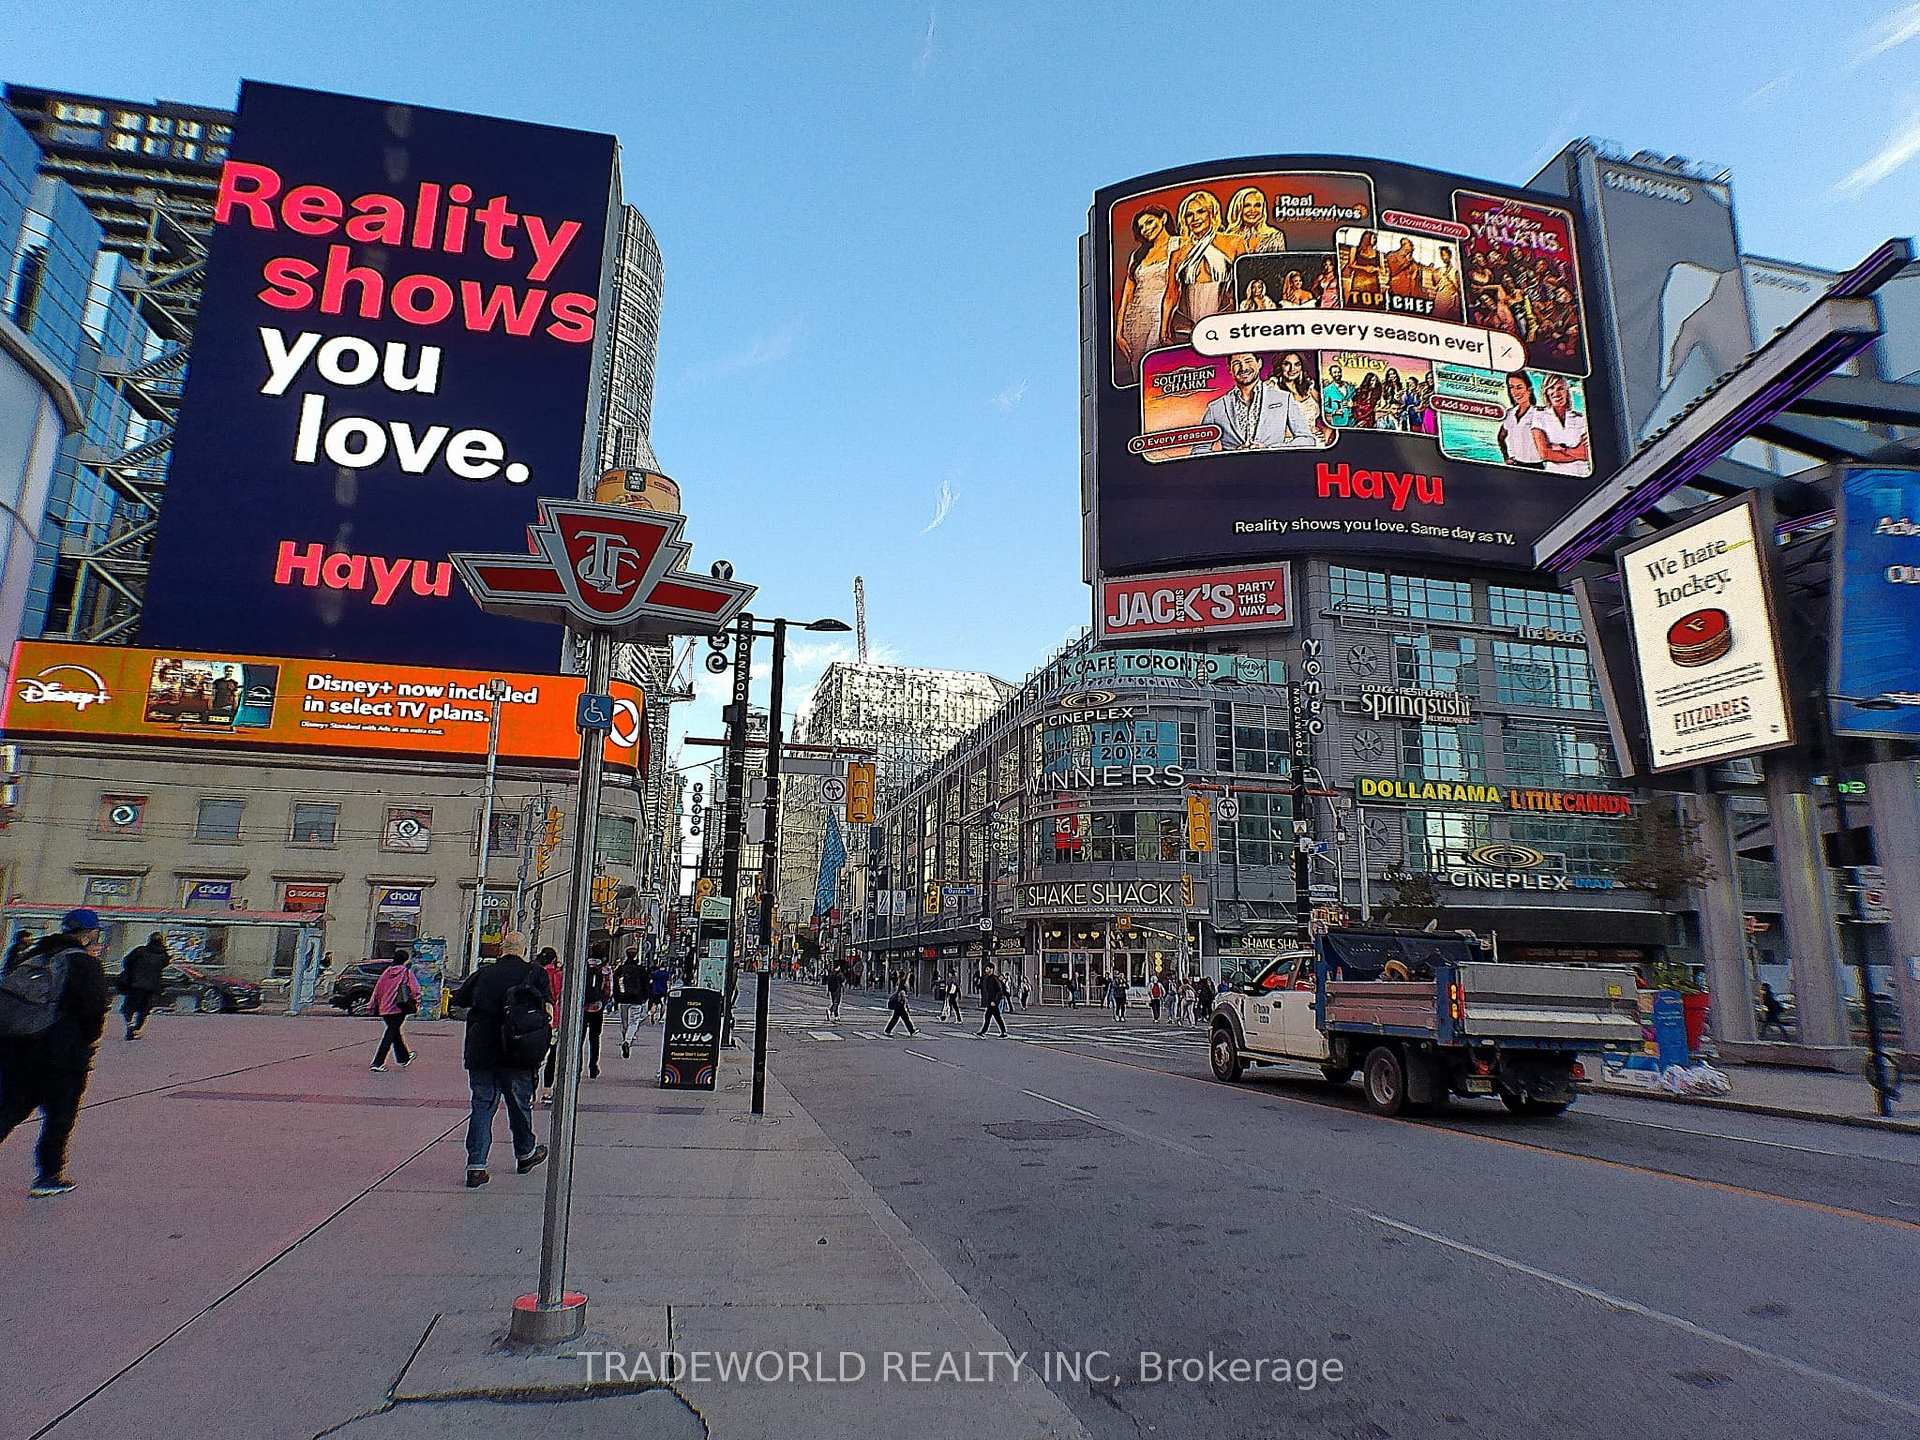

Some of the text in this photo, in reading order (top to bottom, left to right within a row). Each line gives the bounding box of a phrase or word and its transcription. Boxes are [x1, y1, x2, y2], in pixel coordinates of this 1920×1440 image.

[1275, 205, 1361, 220] Housewives
[1281, 195, 1312, 206] Real
[214, 160, 582, 281] Reality
[257, 244, 598, 345] shows
[1349, 290, 1434, 314] TOP CHEF
[1229, 323, 1485, 354] stream every season ever
[258, 327, 442, 396] you
[1154, 370, 1216, 388] SOUTHERN
[1163, 379, 1207, 395] CHARM
[294, 394, 531, 485] love.
[1147, 428, 1214, 448] Every season
[1316, 462, 1445, 511] Hayu
[1235, 517, 1517, 545] Reality shows you love. Same day as TV.
[273, 540, 453, 606] Hayu
[1645, 540, 1728, 581] We hate
[1238, 580, 1275, 593] PARTY
[1238, 593, 1267, 605] THIS
[1654, 568, 1732, 608] hockey.
[1108, 584, 1235, 628] JACK'S
[1176, 589, 1185, 622] ASTORS
[1239, 605, 1266, 617] WAY
[735, 620, 750, 701] DOWNTOWN
[1075, 656, 1118, 675] CAFE
[307, 674, 394, 698] Disney+
[398, 682, 444, 698] now
[1302, 639, 1323, 735] Yonge
[1361, 684, 1396, 694] LOUNGE
[303, 695, 491, 724] in select TV plans.
[1048, 707, 1135, 728] CINEPLEX
[1292, 688, 1304, 756] DOWNTOWN
[1674, 696, 1750, 730] FITZDARES
[1026, 765, 1185, 797] WINNERS
[1360, 778, 1501, 804] DOLLARAMA
[1510, 788, 1632, 816] LITTLE CANADA
[1029, 883, 1174, 906] SHAKE SHACK
[1450, 871, 1570, 891] CINEPLEX
[1241, 938, 1276, 951] SHAKE
